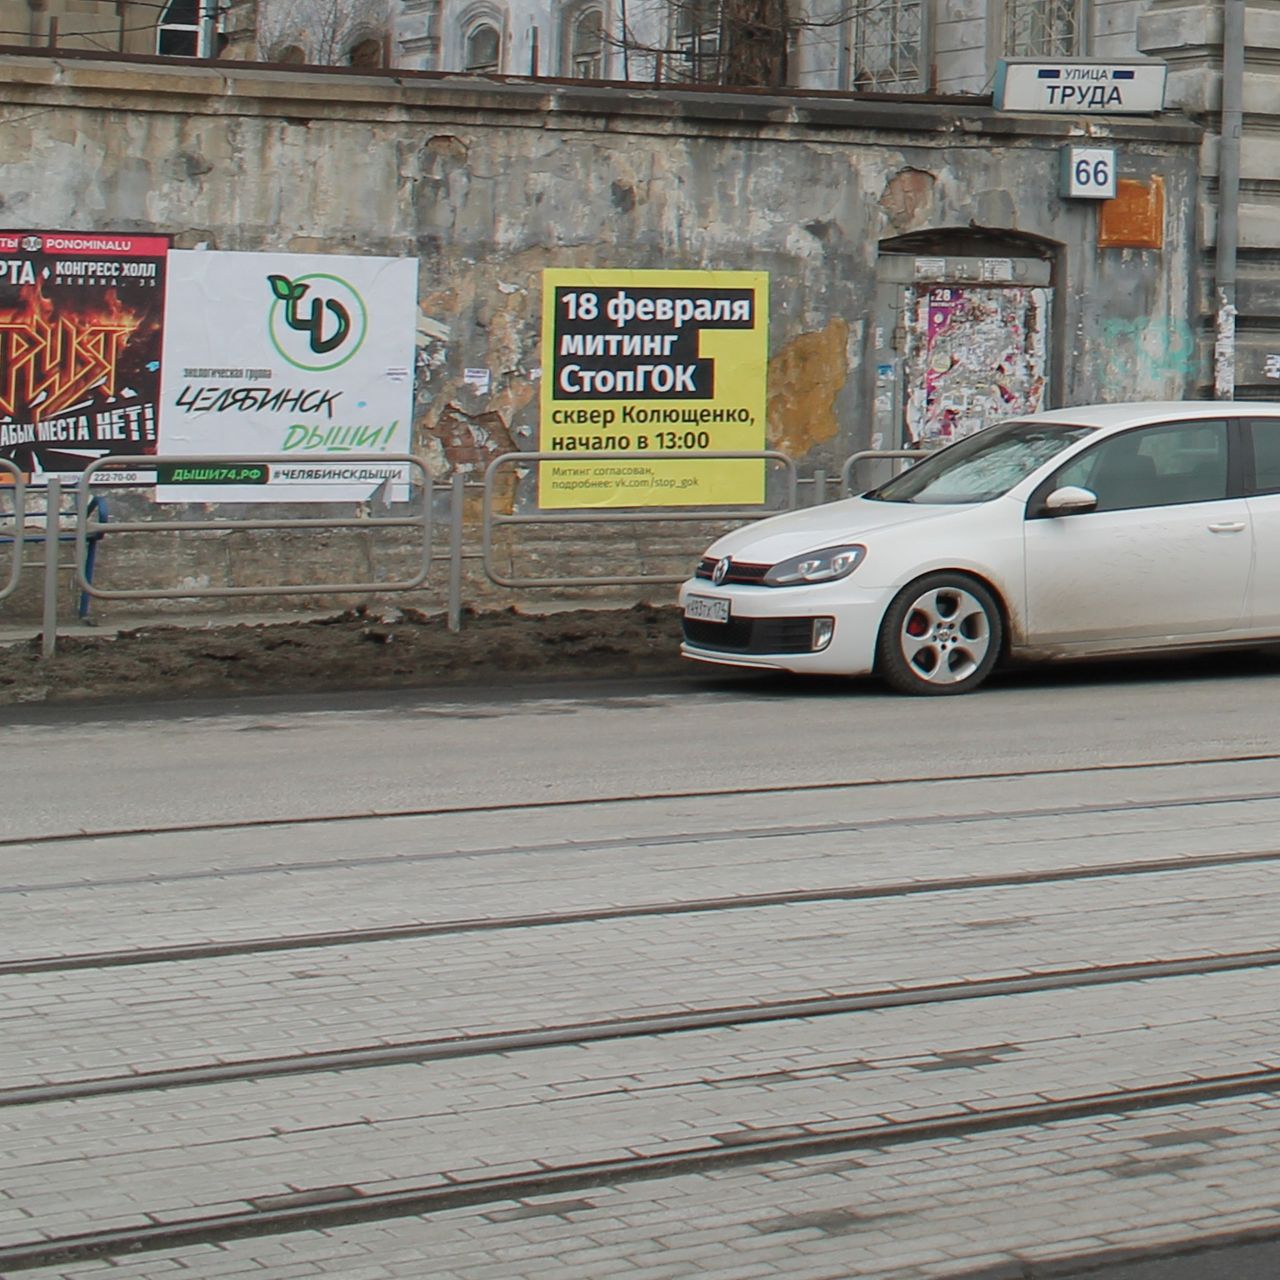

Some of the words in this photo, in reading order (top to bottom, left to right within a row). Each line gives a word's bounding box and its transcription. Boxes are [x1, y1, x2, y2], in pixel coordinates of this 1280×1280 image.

[1064, 70, 1109, 81] УЛИЦА
[1047, 85, 1123, 108] ТРУДА
[1075, 160, 1109, 186] 66
[46, 238, 131, 250] PONOMINALU
[55, 261, 120, 276] КОНГРЕСС
[122, 262, 156, 278] ХОЛЛ
[561, 292, 600, 320] 18
[607, 290, 750, 328] февраля
[560, 334, 678, 356] митинг
[560, 364, 697, 392] СтопГОК
[175, 385, 344, 419] ЧЕЛЯБИНСК
[37, 416, 90, 442] МЕСТА
[96, 403, 156, 441] НЕТ!
[551, 408, 615, 428] сквер
[621, 405, 755, 426] Колющенко,
[281, 420, 399, 451] ДЫШИ!
[551, 435, 631, 451] начало
[637, 435, 649, 450] в
[655, 431, 710, 450] 13:00
[94, 473, 137, 482] 222-70-00
[172, 468, 262, 482] ДЫШИ74.РФ
[273, 468, 402, 480] #ЧЕЛЯБИНСКДЫШИ
[551, 466, 591, 477] Митинг
[593, 467, 655, 477] согласован,
[551, 481, 613, 491] подробнее:
[614, 477, 699, 490] vk.com/stop_gok
